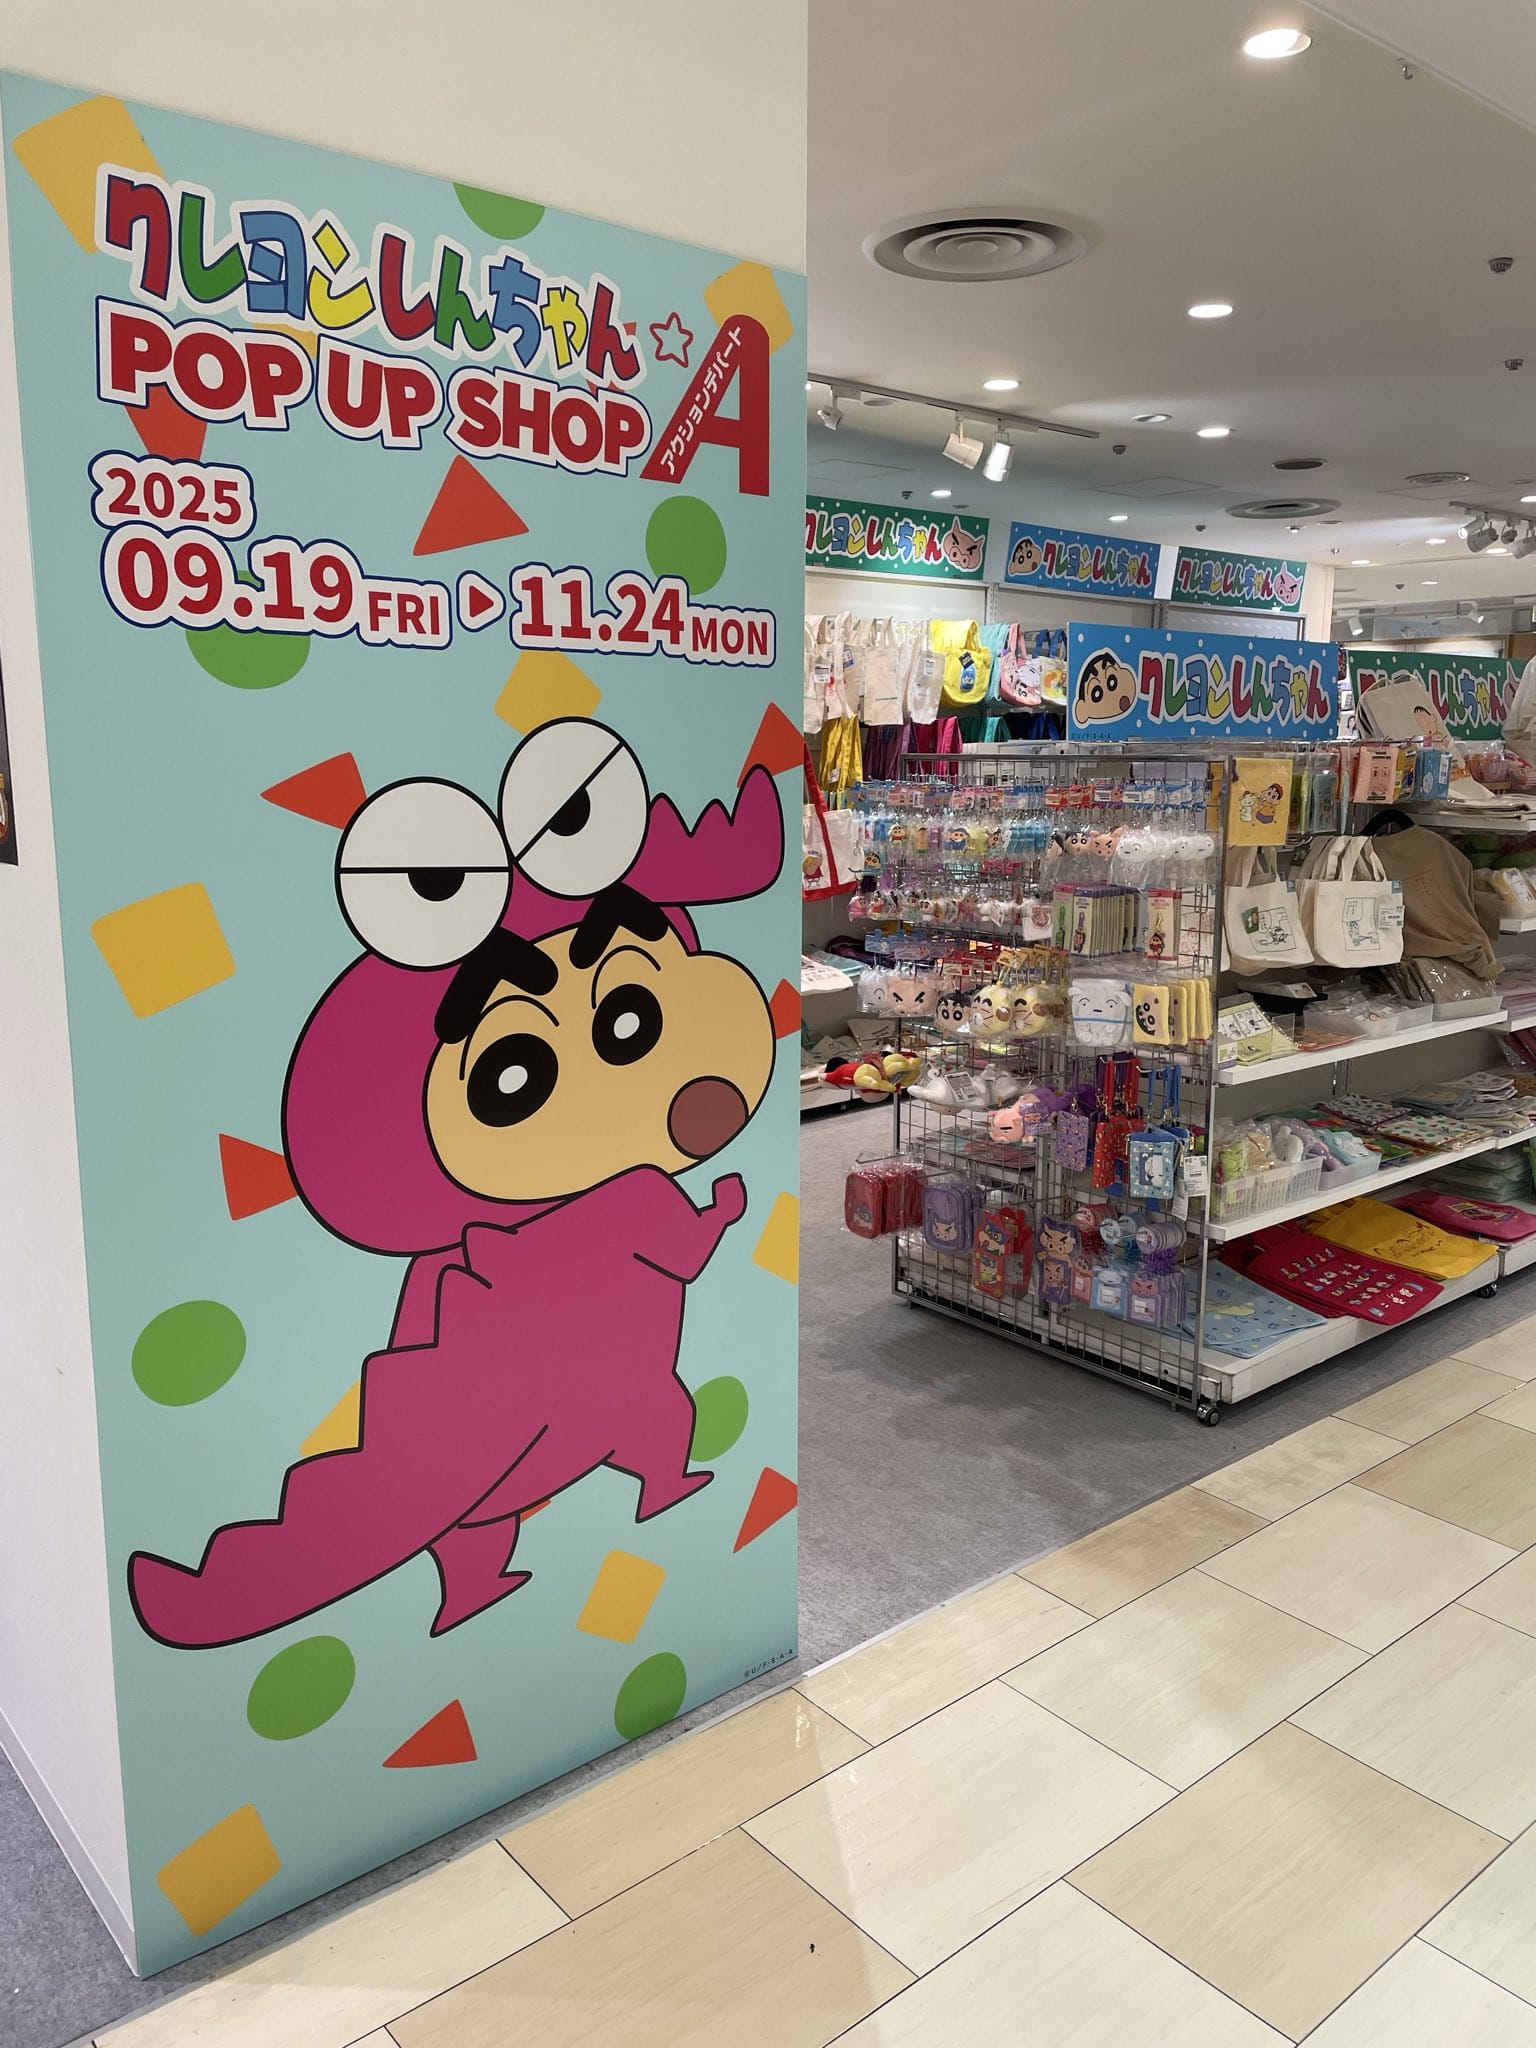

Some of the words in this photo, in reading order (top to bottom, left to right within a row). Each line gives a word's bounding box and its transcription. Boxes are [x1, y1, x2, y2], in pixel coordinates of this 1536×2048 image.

[105, 173, 642, 382] クレヨンしんちゃん
[109, 312, 304, 419] POP
[327, 349, 435, 438] UP
[457, 378, 645, 465] SHOP
[660, 326, 742, 476] アクションデパート
[107, 467, 241, 525] 2025
[806, 511, 942, 561] クレヨンしんちゃん
[1044, 541, 1151, 586] クレヨンしんちゃん
[118, 537, 353, 623] 09.19
[368, 591, 440, 635] FRI
[521, 576, 685, 645] 11.24
[692, 617, 768, 655] MON
[1180, 560, 1273, 598] クレヨンしんちゃん
[1141, 655, 1328, 721] クレヨンしんちゃん
[1359, 672, 1507, 723] しんちゃん
